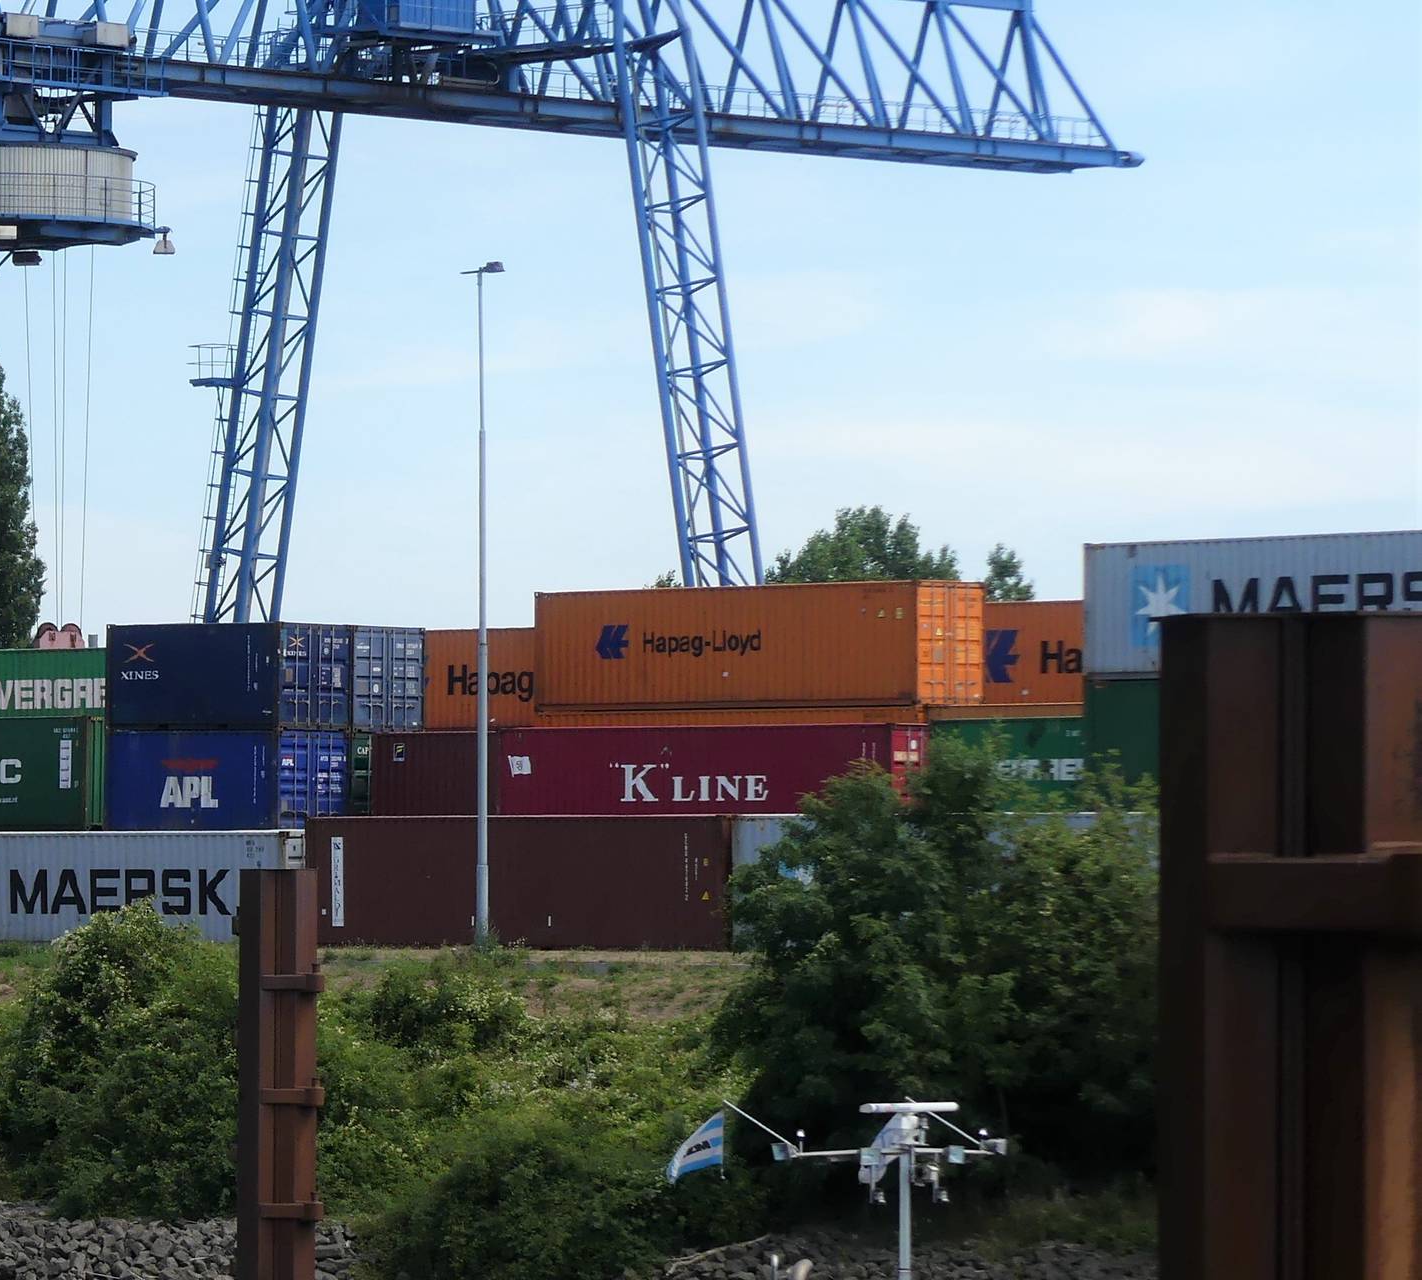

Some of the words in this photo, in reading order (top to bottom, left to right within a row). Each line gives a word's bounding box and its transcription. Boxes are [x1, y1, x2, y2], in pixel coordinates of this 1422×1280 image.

[1212, 571, 1422, 613] MAER
[642, 630, 762, 657] Hapag-Lloyd
[121, 670, 160, 681] XINES
[160, 775, 219, 809] APL
[672, 775, 769, 802] LINE
[9, 868, 232, 916] MAERSK
